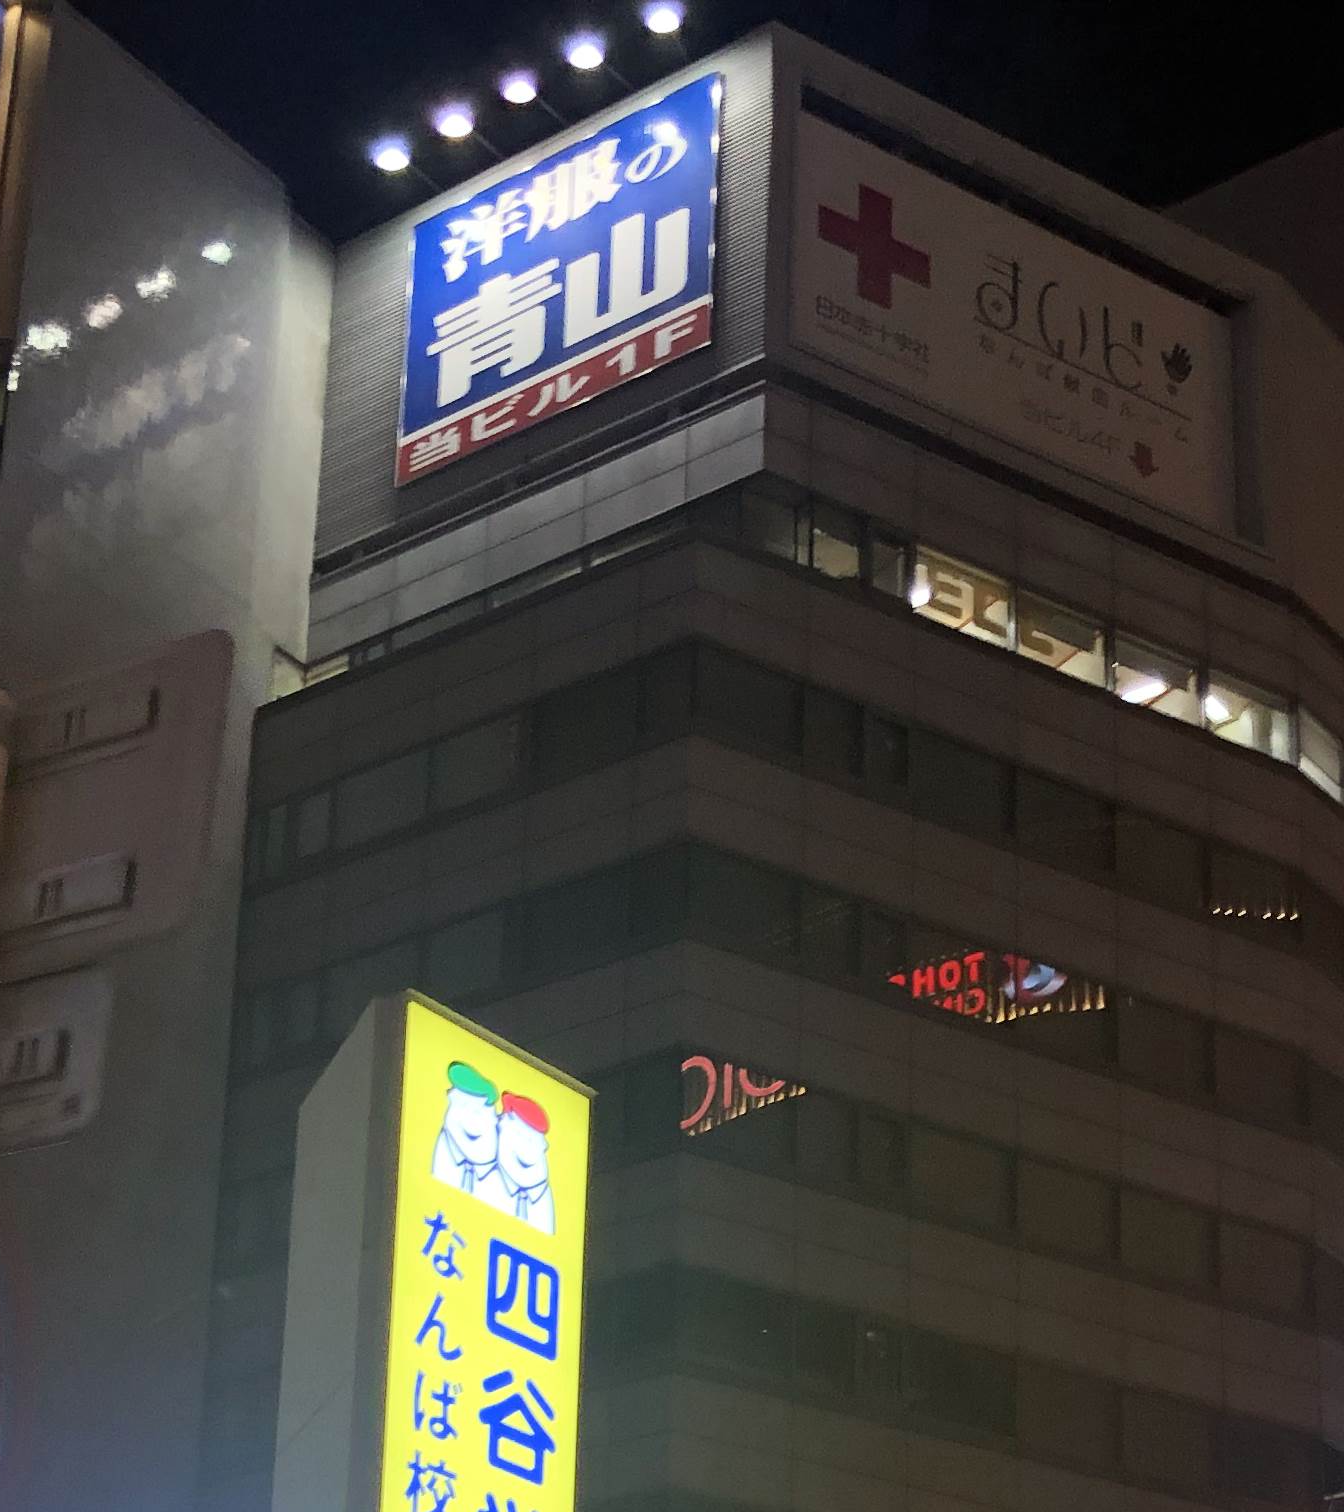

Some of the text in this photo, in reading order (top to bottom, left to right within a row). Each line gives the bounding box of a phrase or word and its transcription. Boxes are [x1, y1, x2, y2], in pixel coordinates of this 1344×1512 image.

[440, 121, 687, 283] 洋服の
[426, 208, 691, 407] 青山
[409, 312, 698, 473] 当ビル1F
